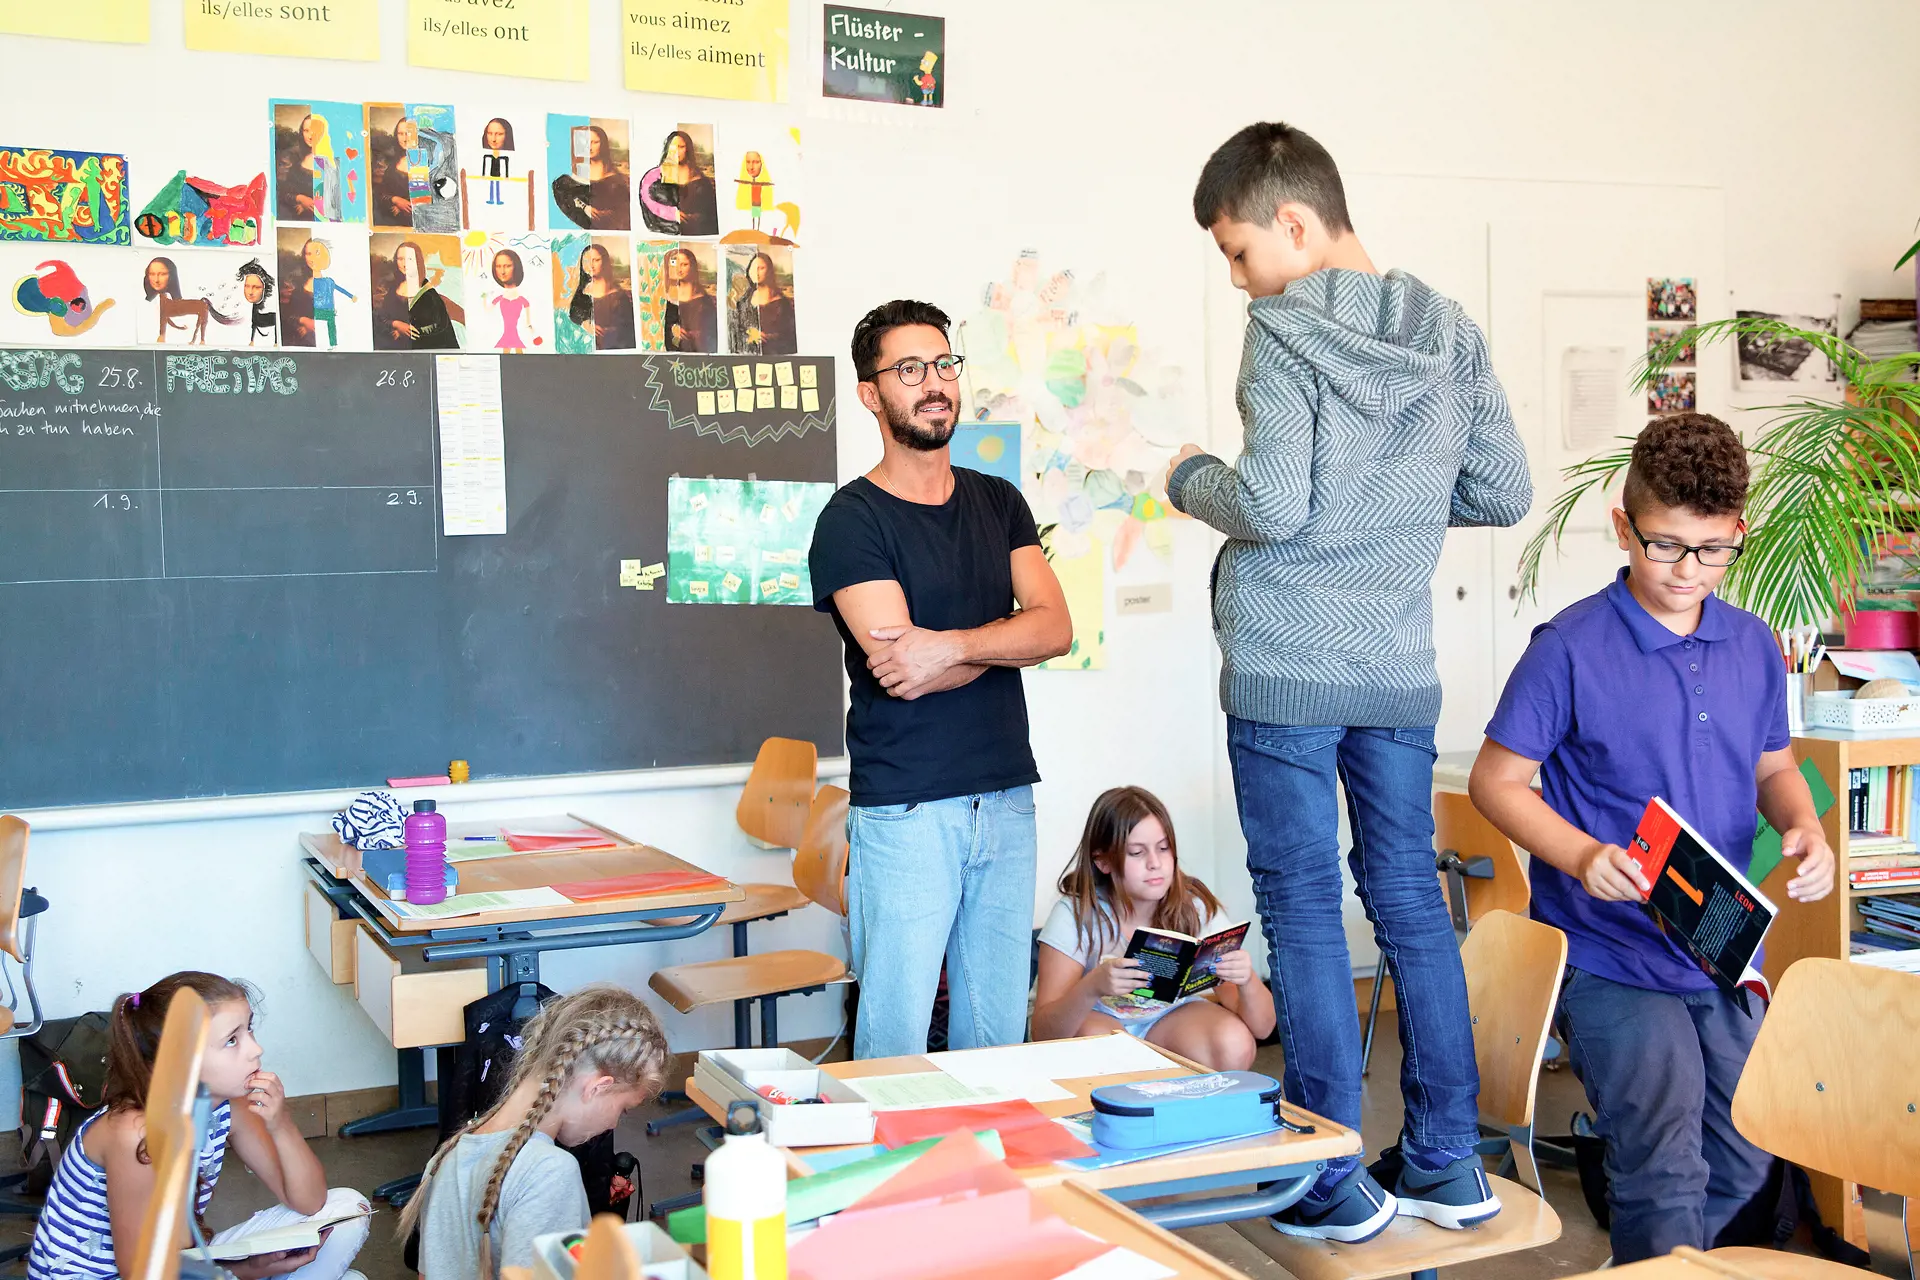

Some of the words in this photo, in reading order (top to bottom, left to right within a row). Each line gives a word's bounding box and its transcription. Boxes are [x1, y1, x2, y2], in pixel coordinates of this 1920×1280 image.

[202, 0, 273, 20] ils/elles
[280, 5, 331, 22] sont
[630, 12, 666, 27] vous
[672, 11, 731, 34] aimez
[423, 17, 488, 37] ils/elles
[494, 25, 530, 42] ont
[831, 14, 903, 42] Flüster
[631, 41, 692, 60] ils/elles
[697, 45, 766, 68] aiment
[831, 46, 896, 74] Kultur
[98, 366, 143, 389] 25.8.
[376, 369, 415, 388] 26.8.
[673, 363, 730, 389] BONUS
[41, 420, 70, 435] tun
[82, 419, 135, 436] haben
[1734, 890, 1755, 913] LEON
